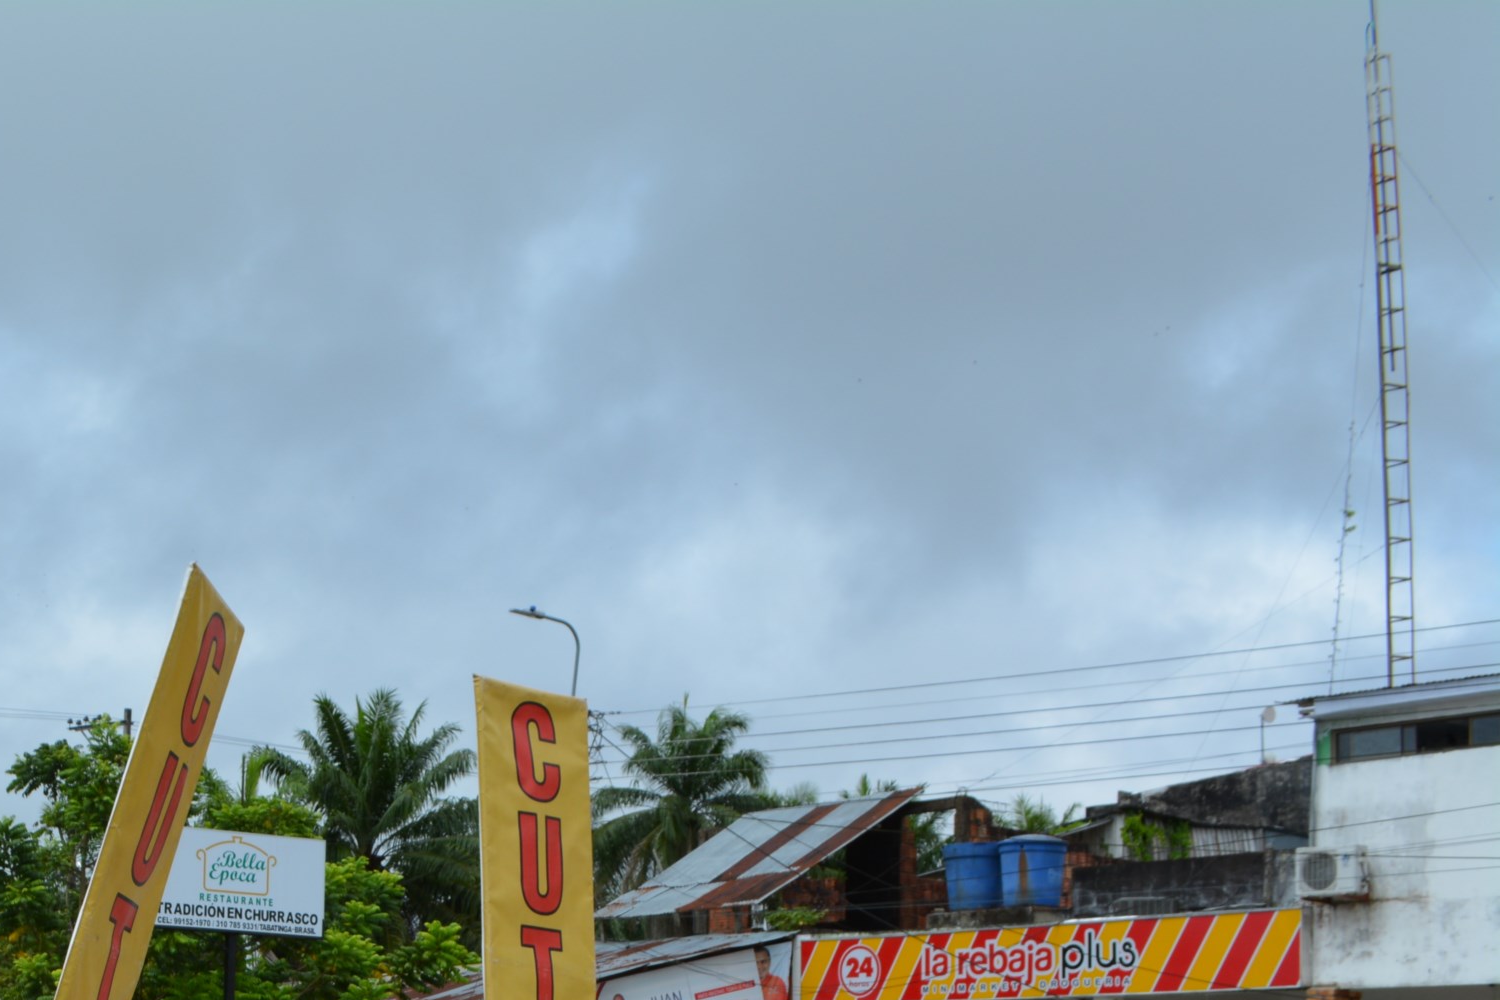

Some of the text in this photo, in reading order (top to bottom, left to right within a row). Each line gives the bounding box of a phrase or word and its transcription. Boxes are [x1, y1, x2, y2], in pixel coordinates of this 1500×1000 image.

[219, 850, 267, 872] Bella
[199, 893, 274, 907] RESTAURANTE
[227, 907, 243, 921] EN
[244, 909, 318, 926] CHURRASCO
[846, 956, 874, 979] 24
[924, 931, 1136, 985] la rebaja plus
[921, 976, 1132, 994] MINIMARKET DROGUERIA
